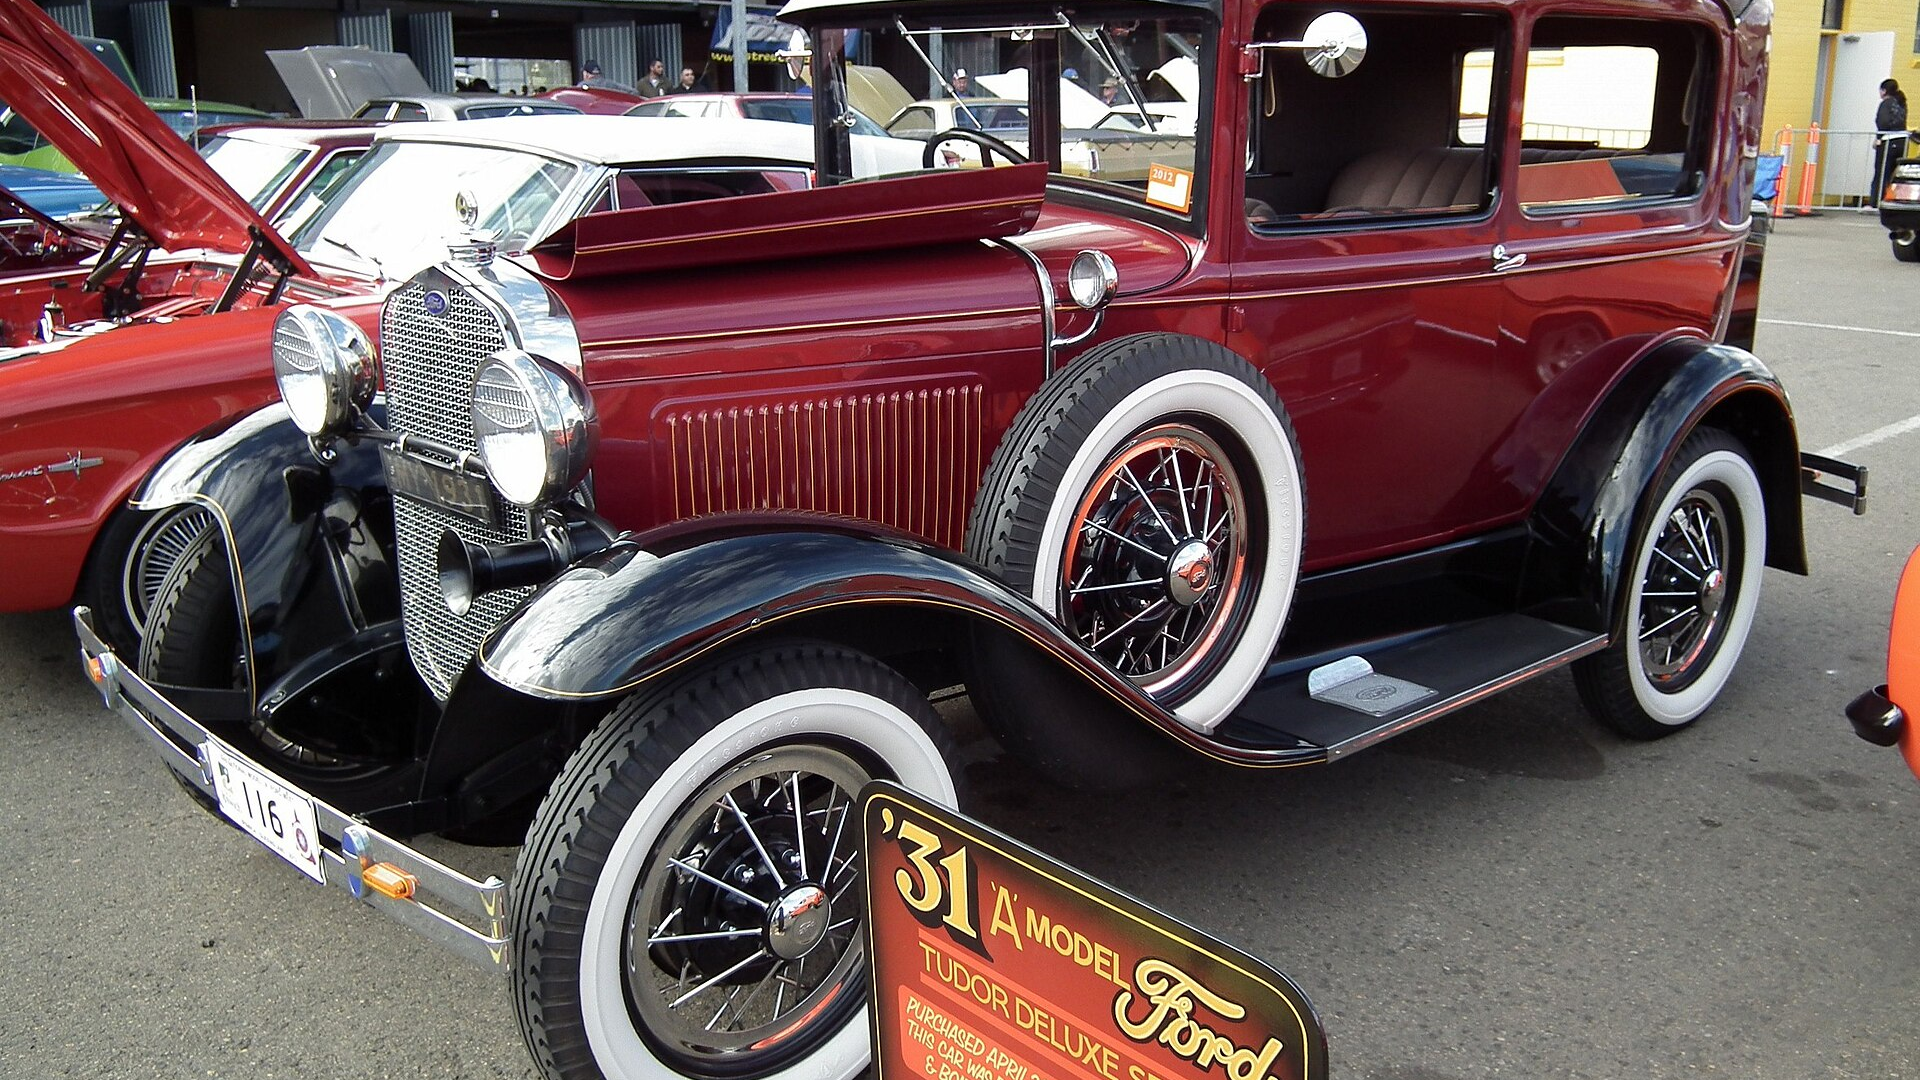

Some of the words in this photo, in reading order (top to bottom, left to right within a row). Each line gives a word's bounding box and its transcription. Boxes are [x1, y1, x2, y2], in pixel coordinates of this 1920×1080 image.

[1152, 168, 1175, 183] 2012
[242, 781, 284, 839] 116
[881, 807, 978, 940] '31
[1026, 906, 1132, 992] MODEL
[906, 995, 986, 1057] PURCHASED
[918, 940, 1011, 1019] TUDOR
[1015, 996, 1120, 1080] DELUXE
[1114, 957, 1285, 1080] Ford
[907, 1018, 936, 1051] THIS
[937, 1041, 964, 1070] CAR
[925, 1055, 938, 1075] &
